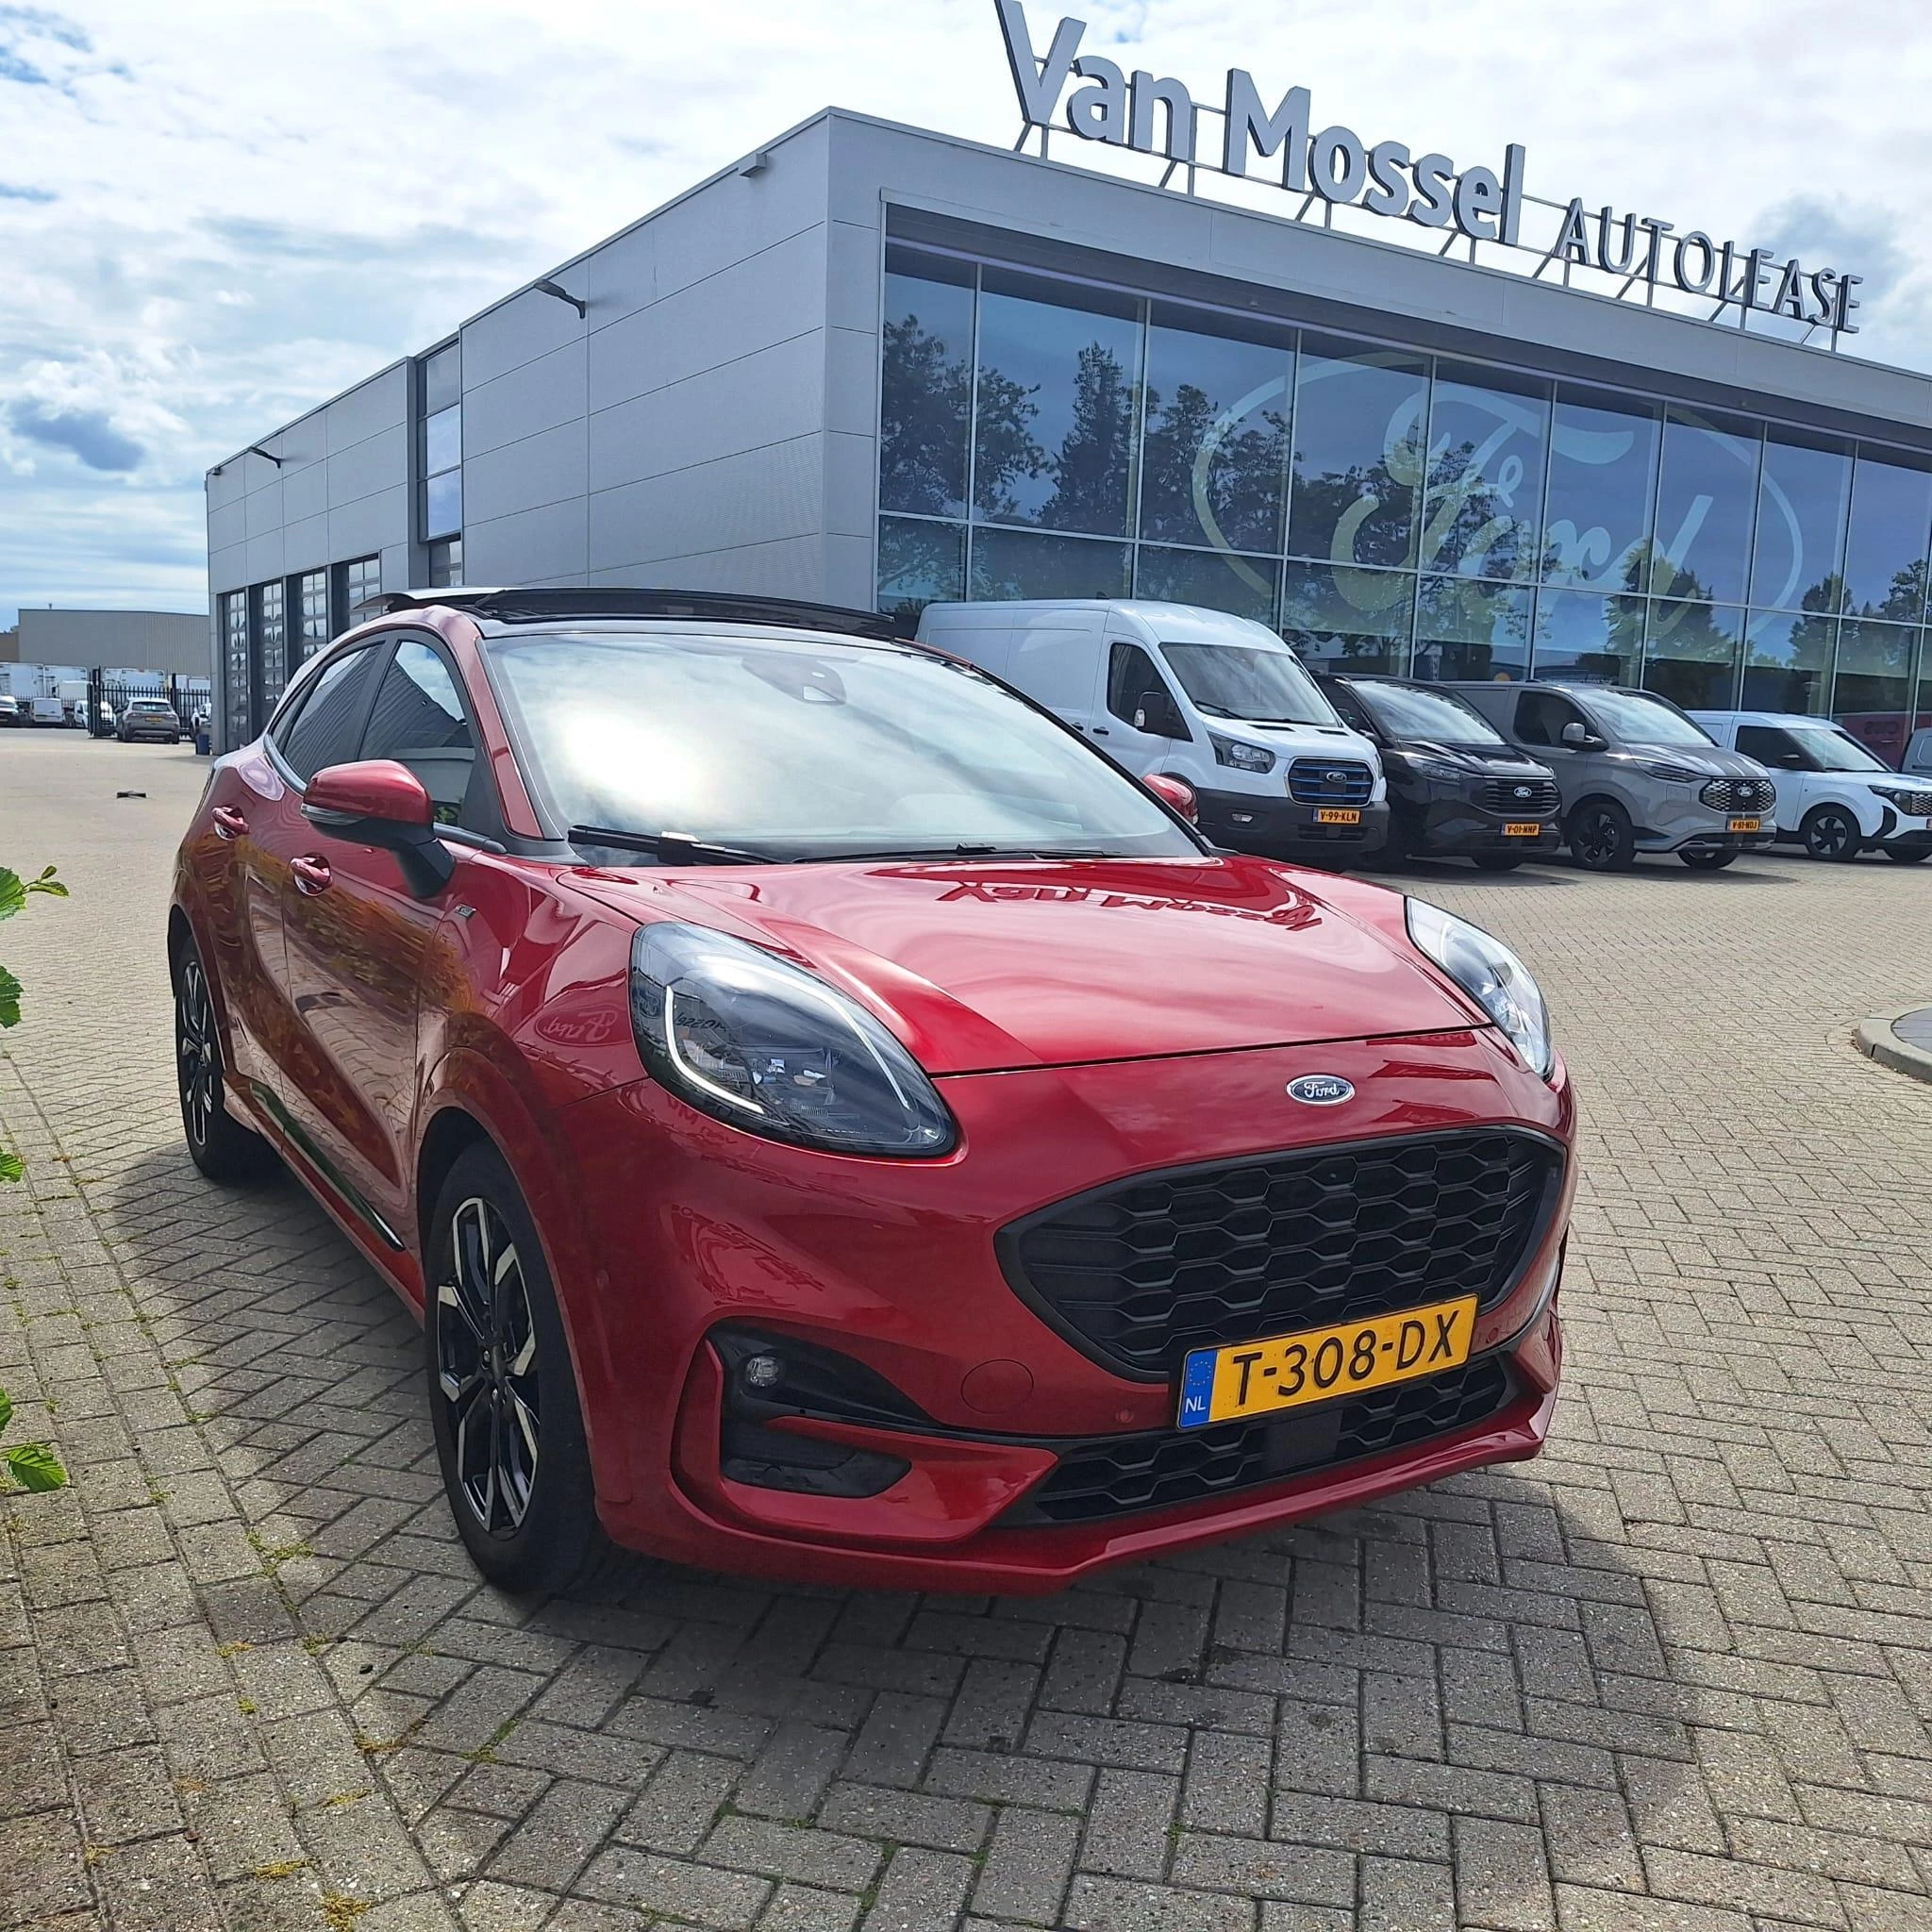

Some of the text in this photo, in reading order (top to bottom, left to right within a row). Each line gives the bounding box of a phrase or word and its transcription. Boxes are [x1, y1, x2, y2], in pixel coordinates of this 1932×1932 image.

[994, 0, 1864, 335] Van Mossel AUTOLEASE
[1330, 384, 1714, 634] Ford
[1304, 1081, 1340, 1098] Ford
[1184, 1393, 1207, 1414] NL
[1232, 1309, 1460, 1406] T-308-DX
